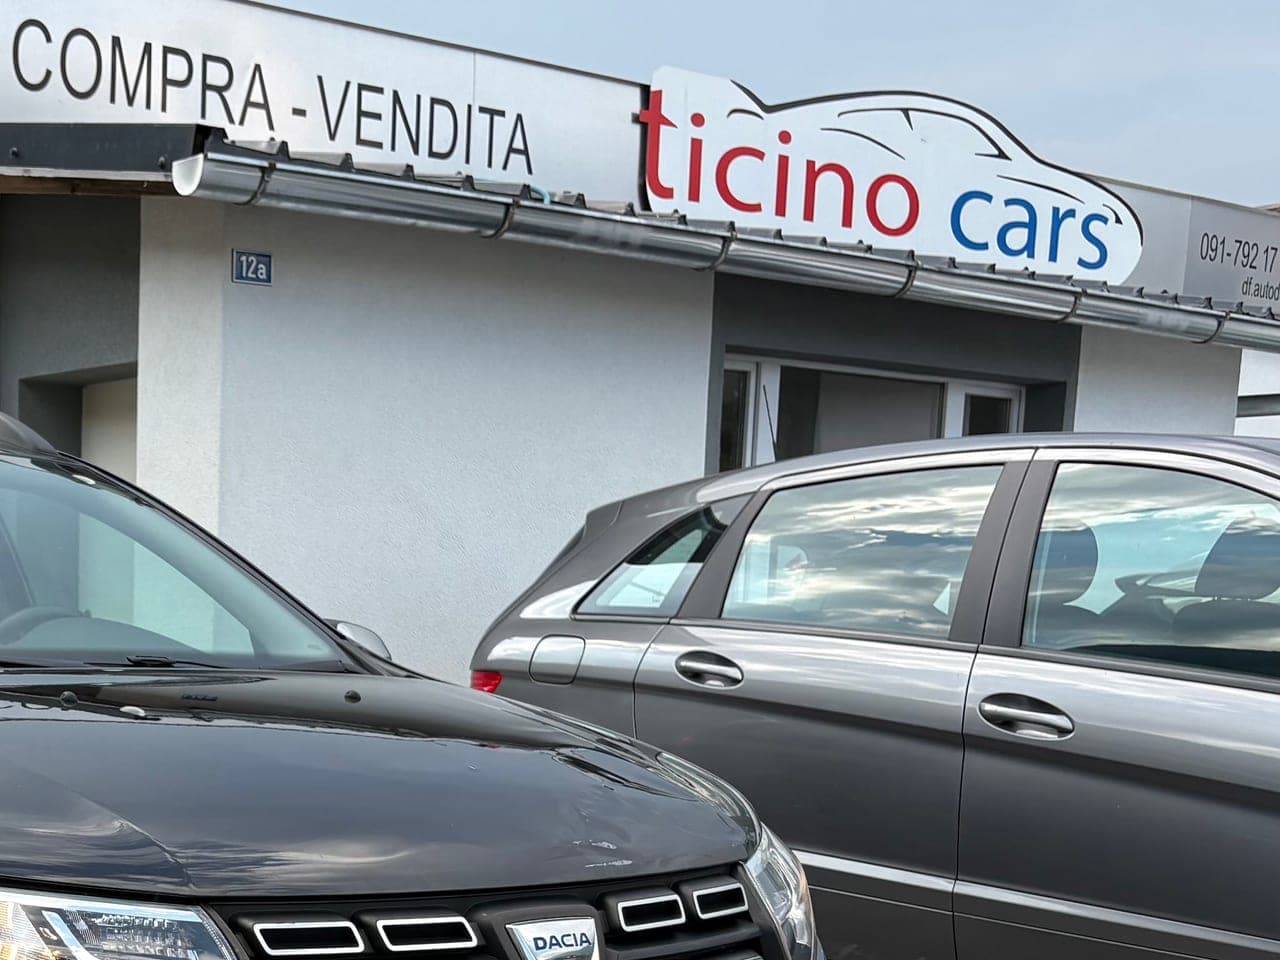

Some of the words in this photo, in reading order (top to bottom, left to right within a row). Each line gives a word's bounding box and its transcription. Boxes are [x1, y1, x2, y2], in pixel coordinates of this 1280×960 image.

[12, 18, 275, 132] COMPRA
[317, 75, 533, 176] VENDITA
[639, 89, 920, 237] ticino
[950, 190, 1110, 270] cars
[239, 255, 267, 280] 12a
[1200, 232, 1259, 270] 091-792
[1263, 245, 1278, 273] 17
[533, 932, 592, 951] DACIA
